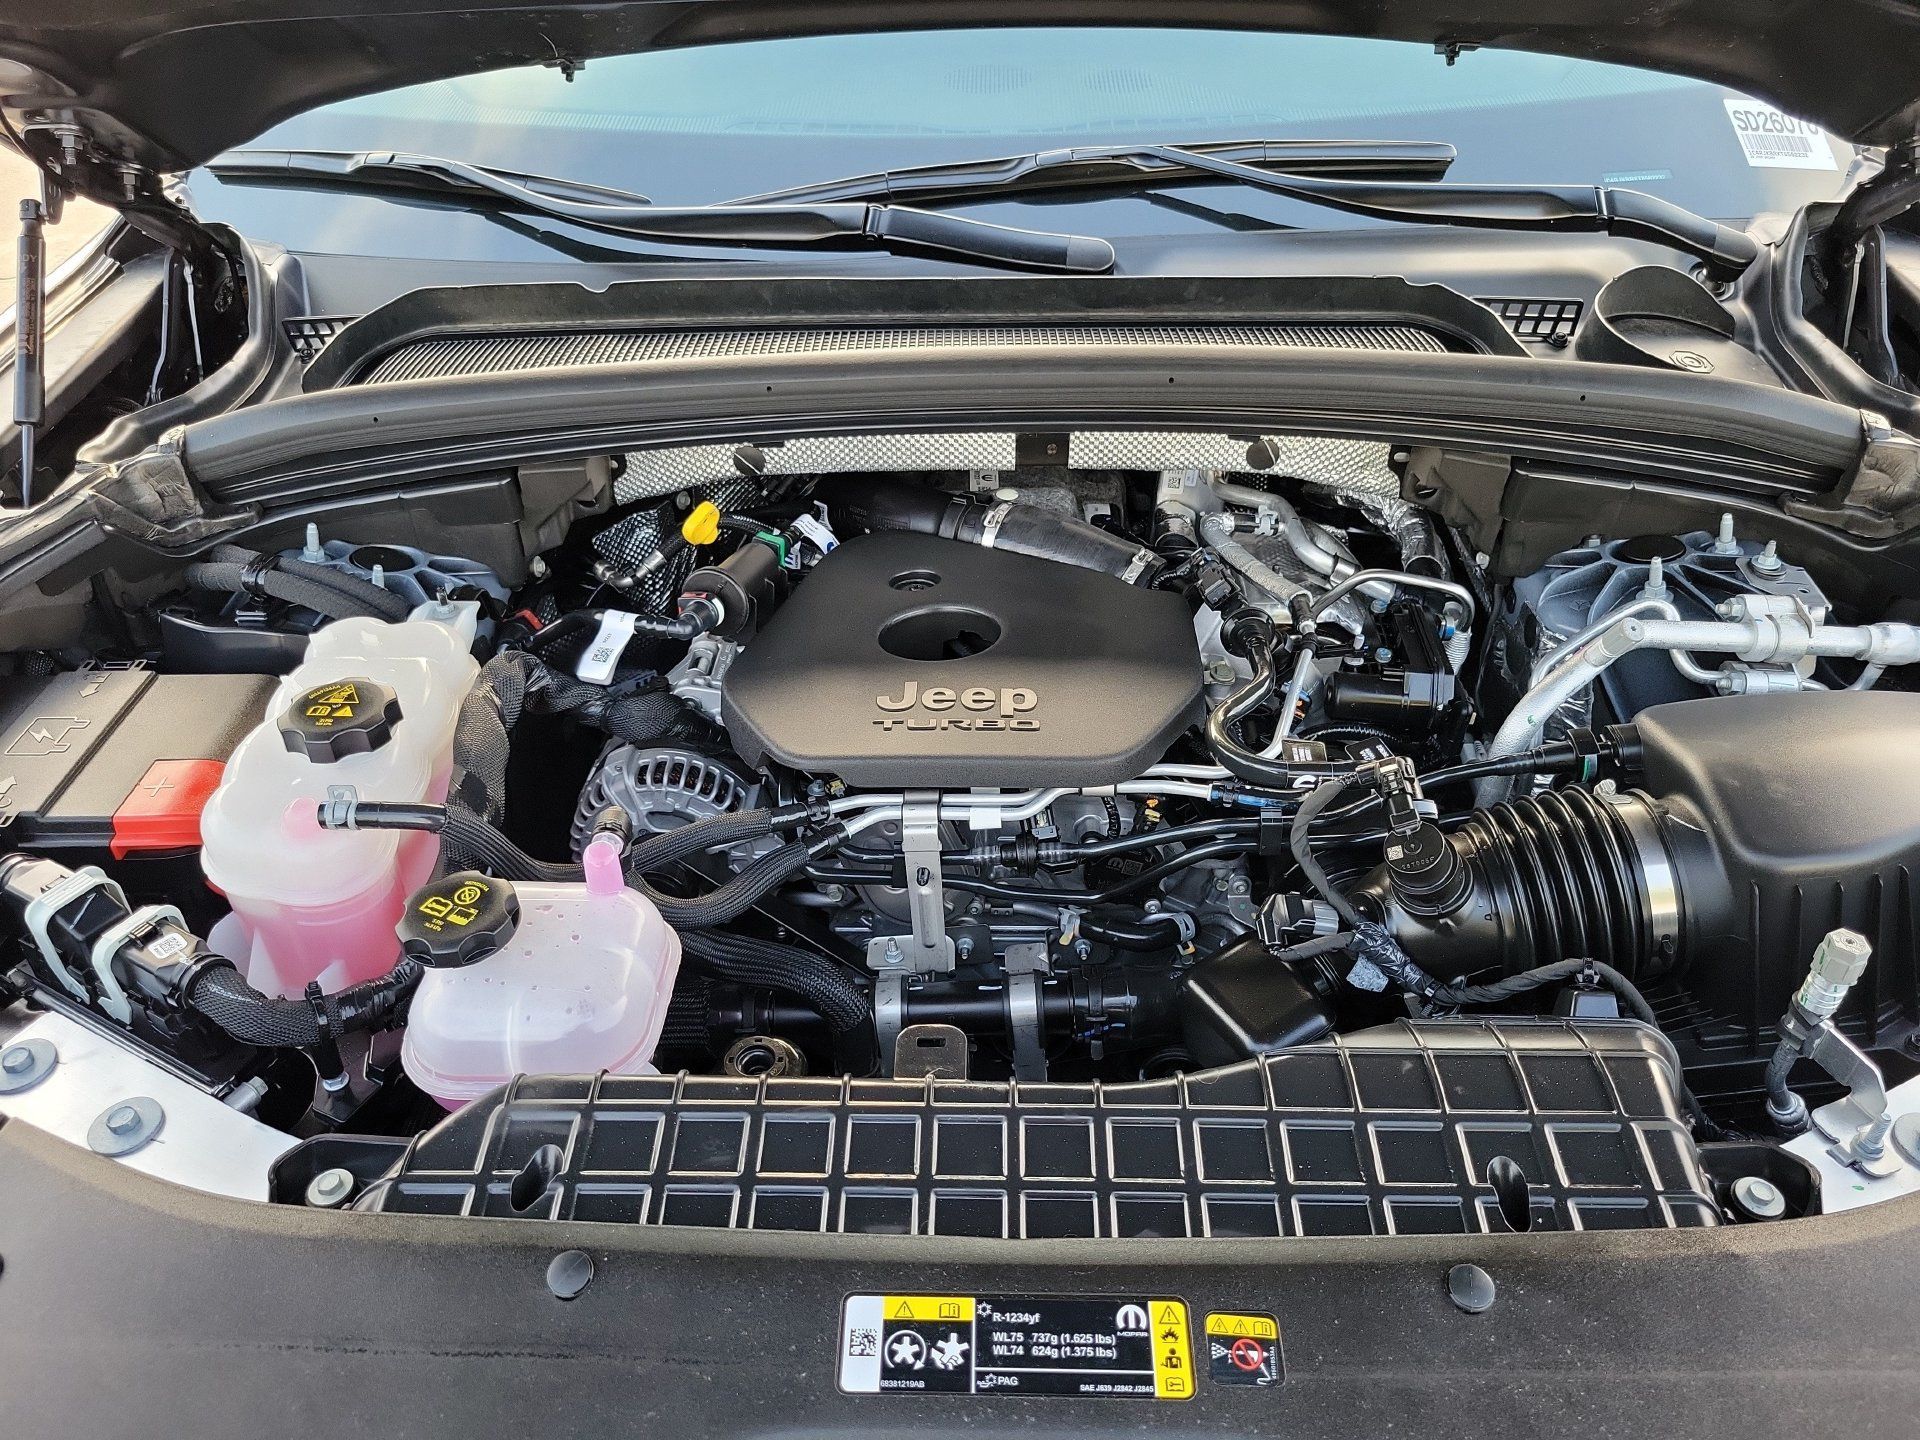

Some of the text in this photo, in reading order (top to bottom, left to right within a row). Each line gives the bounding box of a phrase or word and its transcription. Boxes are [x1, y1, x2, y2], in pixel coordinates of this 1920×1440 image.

[876, 681, 1038, 718] Jeep
[872, 719, 1040, 731] TURBO
[993, 1313, 1040, 1324] R-1234yf
[993, 1332, 1116, 1345] WL75 737g (1.625 lbs)
[993, 1345, 1117, 1359] WL74 624g (1.375 lbs)
[880, 1380, 925, 1388] 68381219AB
[998, 1376, 1019, 1386] PAG
[1080, 1384, 1154, 1393] SAE J639 J2842 J2845
